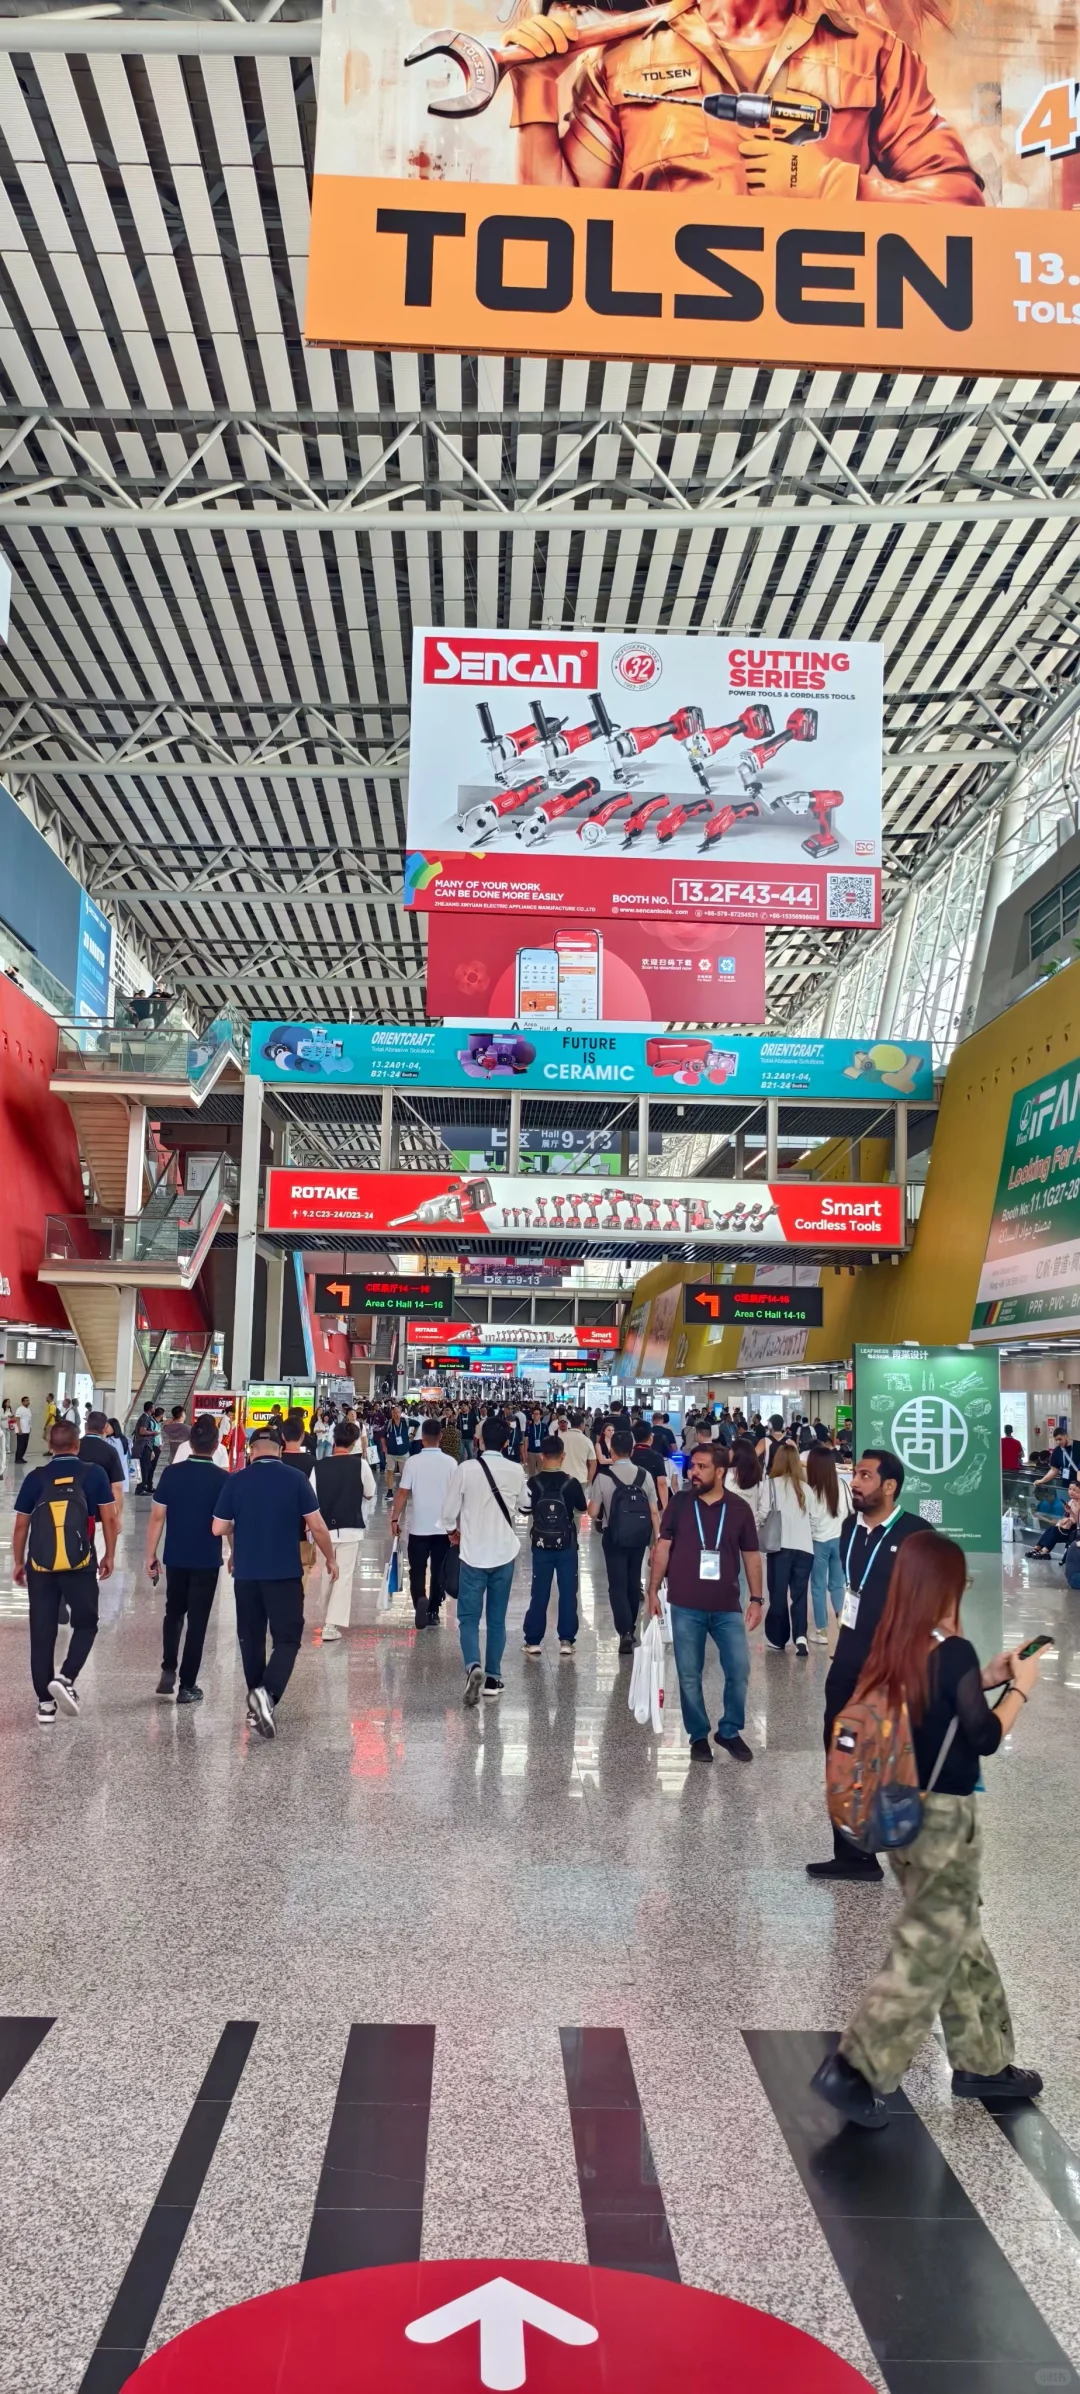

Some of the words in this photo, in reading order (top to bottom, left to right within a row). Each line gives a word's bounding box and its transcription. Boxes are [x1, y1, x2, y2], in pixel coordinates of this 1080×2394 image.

[463, 43, 485, 84] TOLSEN
[642, 68, 692, 82] TOLSEN
[774, 107, 815, 121] TOLSEN
[790, 155, 799, 189] TOLSEN
[376, 208, 973, 332] TOLSEN
[434, 642, 582, 684] SENCAN
[628, 657, 653, 678] 32
[728, 649, 850, 672] CUTTING
[729, 669, 826, 690] SERIES
[435, 880, 464, 888] MANY
[482, 882, 508, 890] YOUR
[510, 882, 540, 891] WORK
[434, 889, 456, 897] CAN
[458, 890, 470, 898] BE
[472, 890, 500, 899] DONE
[502, 892, 530, 900] MORE
[532, 892, 564, 901] EASILY
[612, 894, 650, 904] BOOTH
[652, 896, 669, 905] NO.
[678, 881, 813, 906] 13.2F43-44
[641, 958, 692, 966] 欢迎扫码下载
[372, 1032, 435, 1046] ORIENTCRAFT
[562, 1036, 616, 1050] FUTURE
[760, 1044, 824, 1057] ORIENTCRAFT
[584, 1052, 596, 1064] IS
[372, 1061, 421, 1070] 13.2A01-04,
[544, 1064, 636, 1081] CERAMIC
[370, 1070, 401, 1078] B21-24
[762, 1072, 811, 1081] 13.2A01-04,
[542, 1130, 559, 1138] Hall
[562, 1130, 612, 1150] 9-13
[542, 1139, 560, 1148] 展厅
[1008, 1155, 1052, 1190] Looking
[1051, 1145, 1074, 1174] For
[292, 1186, 358, 1200] ROTAKE
[821, 1198, 882, 1216] Smart
[1002, 1205, 1019, 1222] Booth
[316, 1210, 374, 1219] C23-24/D23-24
[794, 1218, 846, 1230] Cordless
[849, 1220, 882, 1232] Tools
[516, 1276, 540, 1285] 9-13
[366, 1300, 385, 1308] Area
[396, 1300, 412, 1308] Hall
[1028, 1299, 1044, 1314] PPR
[1048, 1296, 1065, 1312] PVC
[734, 1310, 754, 1318] Area
[764, 1310, 780, 1318] Hall
[784, 1311, 806, 1320] 14-16
